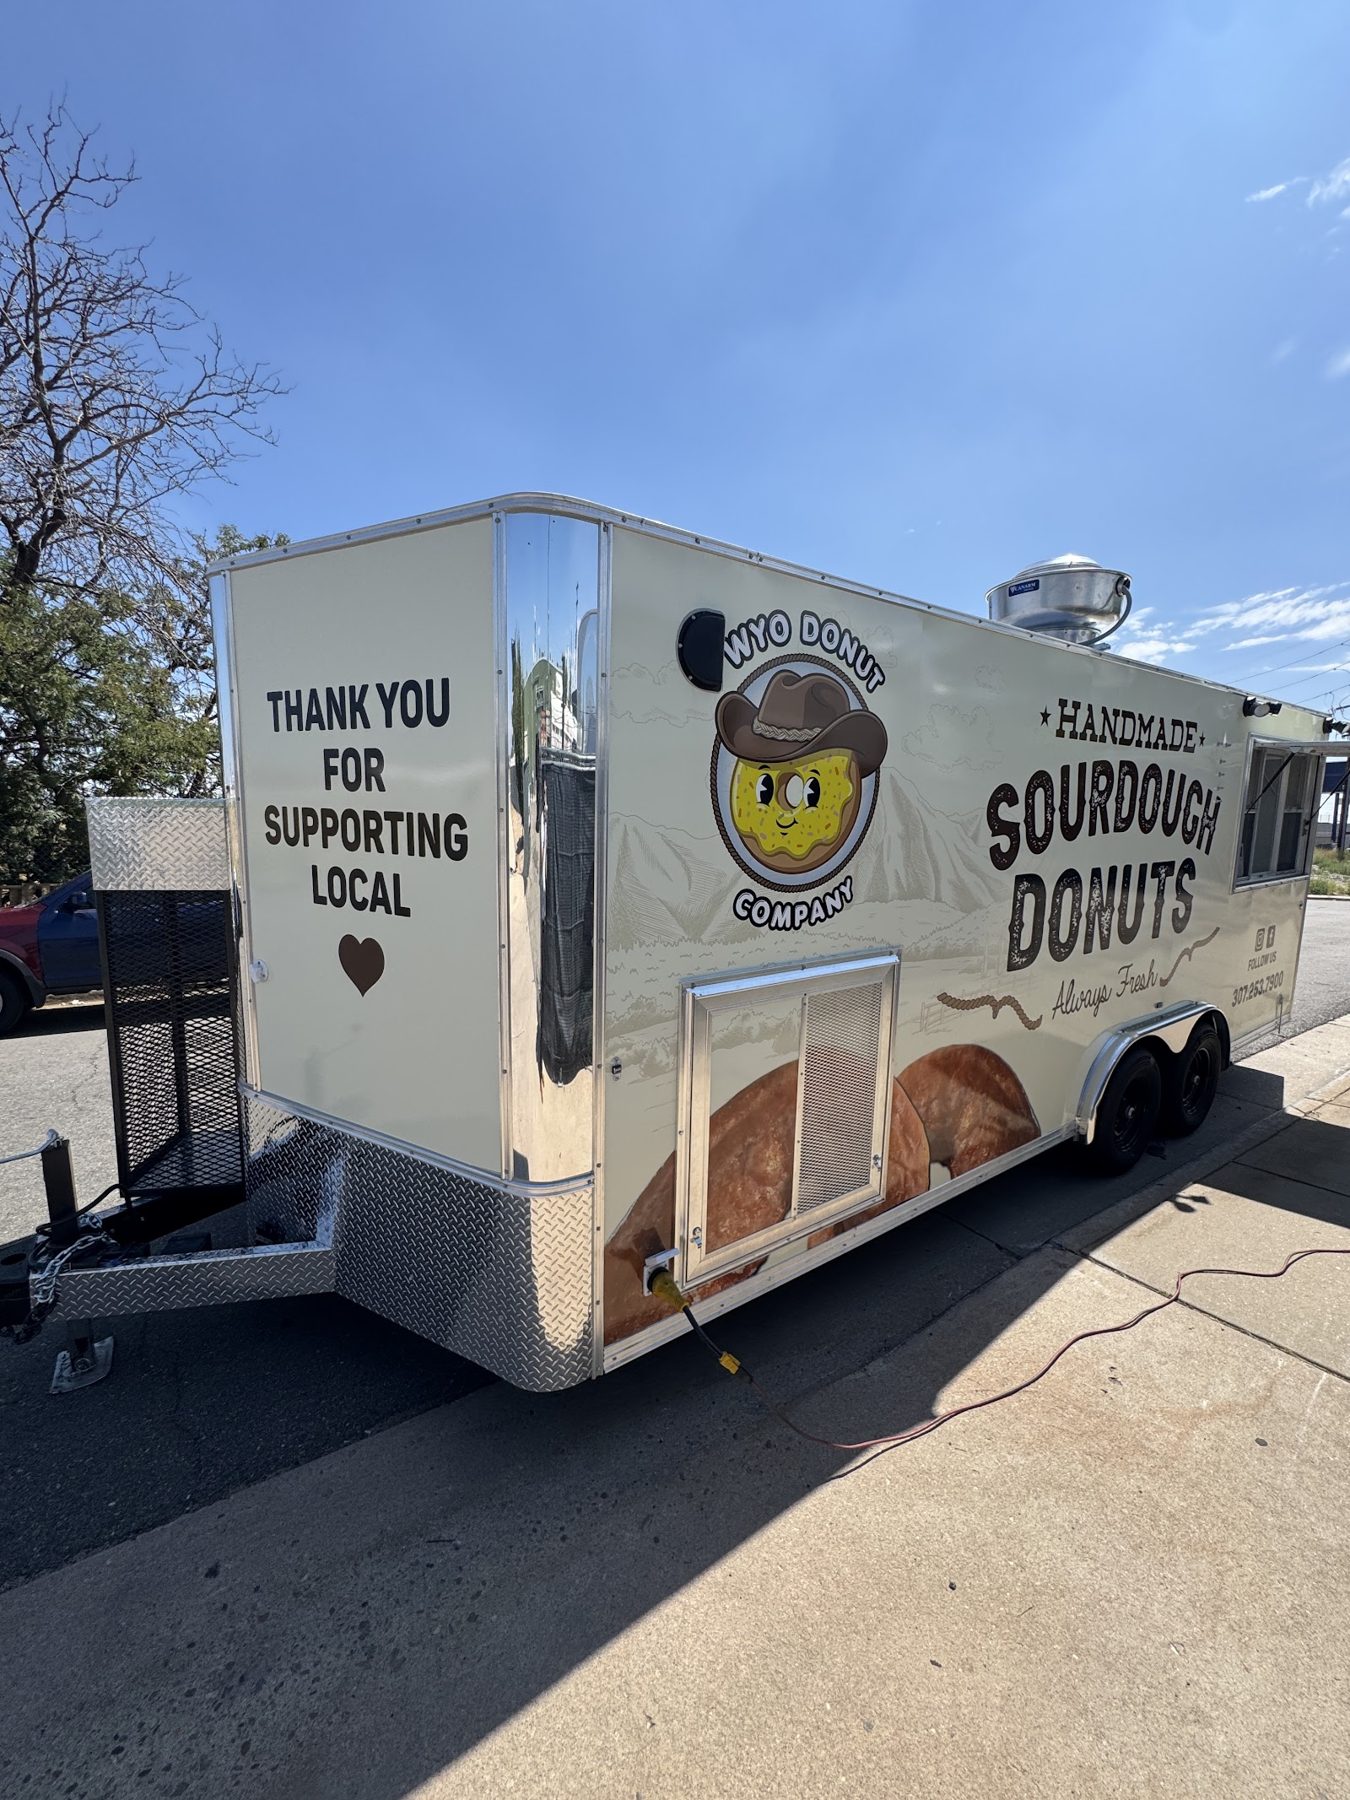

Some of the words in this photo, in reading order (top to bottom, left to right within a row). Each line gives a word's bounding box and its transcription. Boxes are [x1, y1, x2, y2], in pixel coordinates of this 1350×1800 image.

[723, 610, 791, 668] WYO
[801, 610, 885, 693] DONUT
[266, 684, 371, 732] THANK
[376, 677, 450, 728] YOU
[1055, 698, 1198, 753] HANDMADE
[323, 747, 386, 792] FOR
[264, 804, 468, 861] SUPPORTING
[986, 760, 1222, 870] SOURDOUGH
[311, 864, 411, 917] LOCAL
[733, 876, 854, 931] COMPANY
[1006, 857, 1196, 972] DONUTS
[1247, 953, 1270, 971] FOLLOW
[1269, 951, 1277, 964] US
[1052, 979, 1112, 1020] Always
[1116, 959, 1158, 997] Fresh
[1231, 970, 1284, 1008] 307.253.7900
